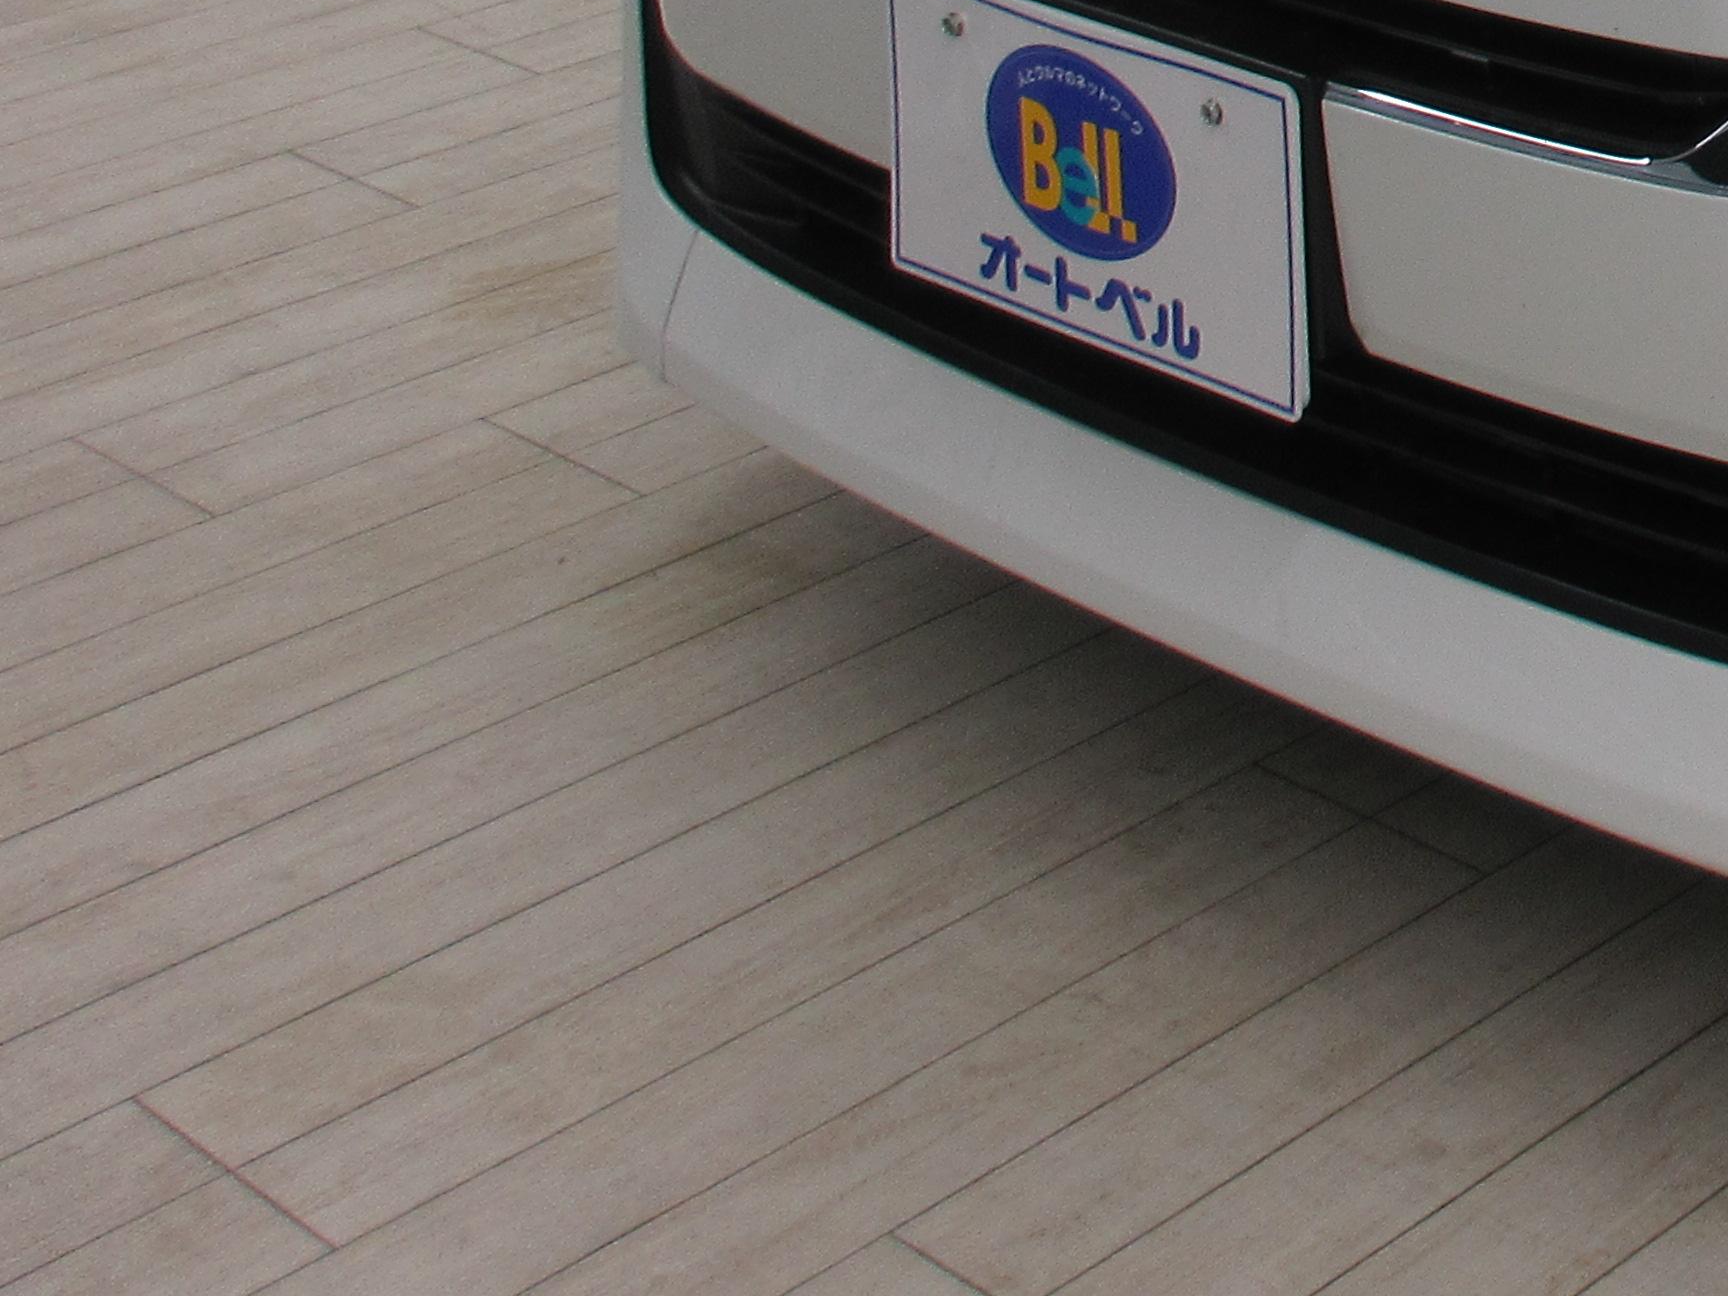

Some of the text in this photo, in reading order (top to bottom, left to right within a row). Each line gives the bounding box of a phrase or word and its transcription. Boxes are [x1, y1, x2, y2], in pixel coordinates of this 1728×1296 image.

[981, 233, 1199, 359] オートベル
